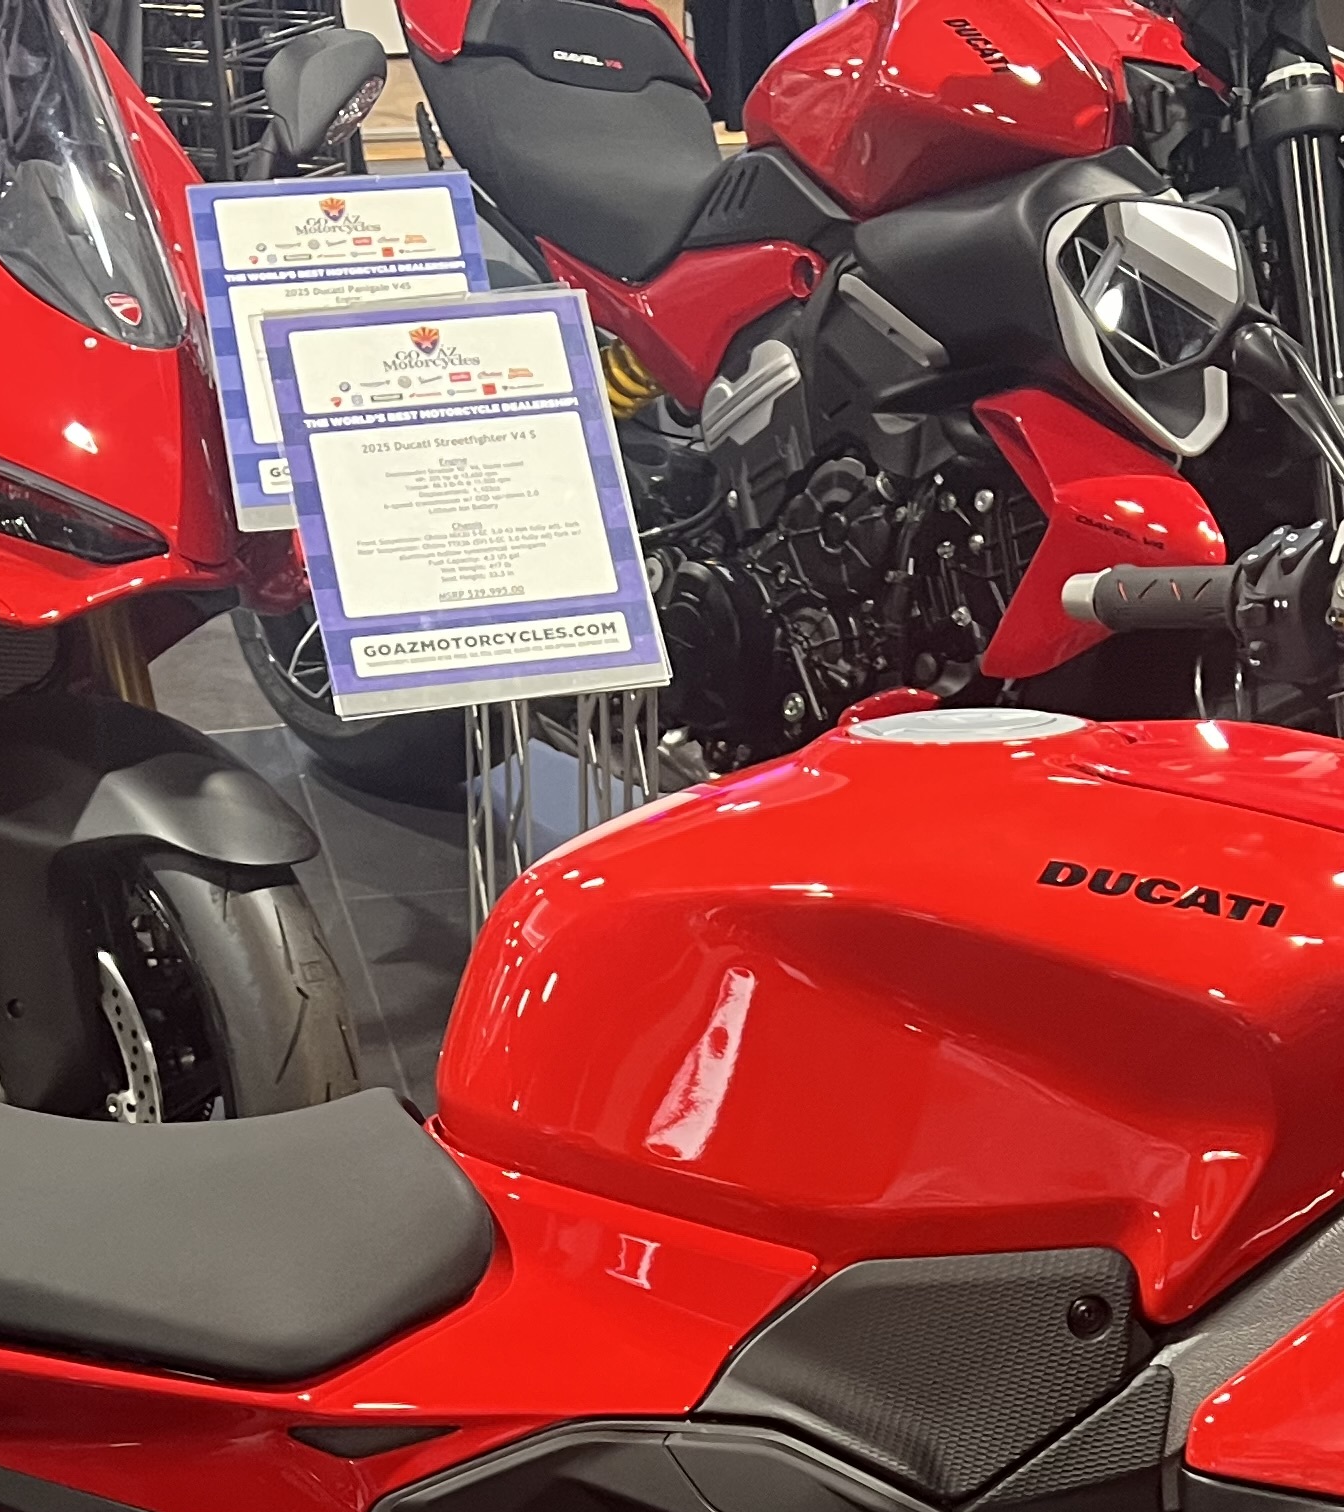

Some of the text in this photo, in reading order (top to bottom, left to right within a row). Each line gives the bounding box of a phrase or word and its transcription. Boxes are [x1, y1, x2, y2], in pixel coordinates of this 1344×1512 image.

[942, 18, 1010, 73] DUCATI
[295, 222, 381, 236] Motorcycles
[325, 264, 397, 278] MOTORCYCLE
[284, 288, 310, 298] 2025
[313, 286, 345, 296] Ducati
[383, 354, 480, 373] Motorcycles
[395, 346, 457, 361] GO AZ
[304, 397, 579, 429] THE WORLD'S BEST MOTORCYCLE DEALERSHIP!
[361, 429, 537, 454] 2025 Ducati Streetfighter V4 S
[364, 621, 617, 658] GOAZMOTORCYCLES.COM
[1036, 860, 1285, 929] DUCATI
